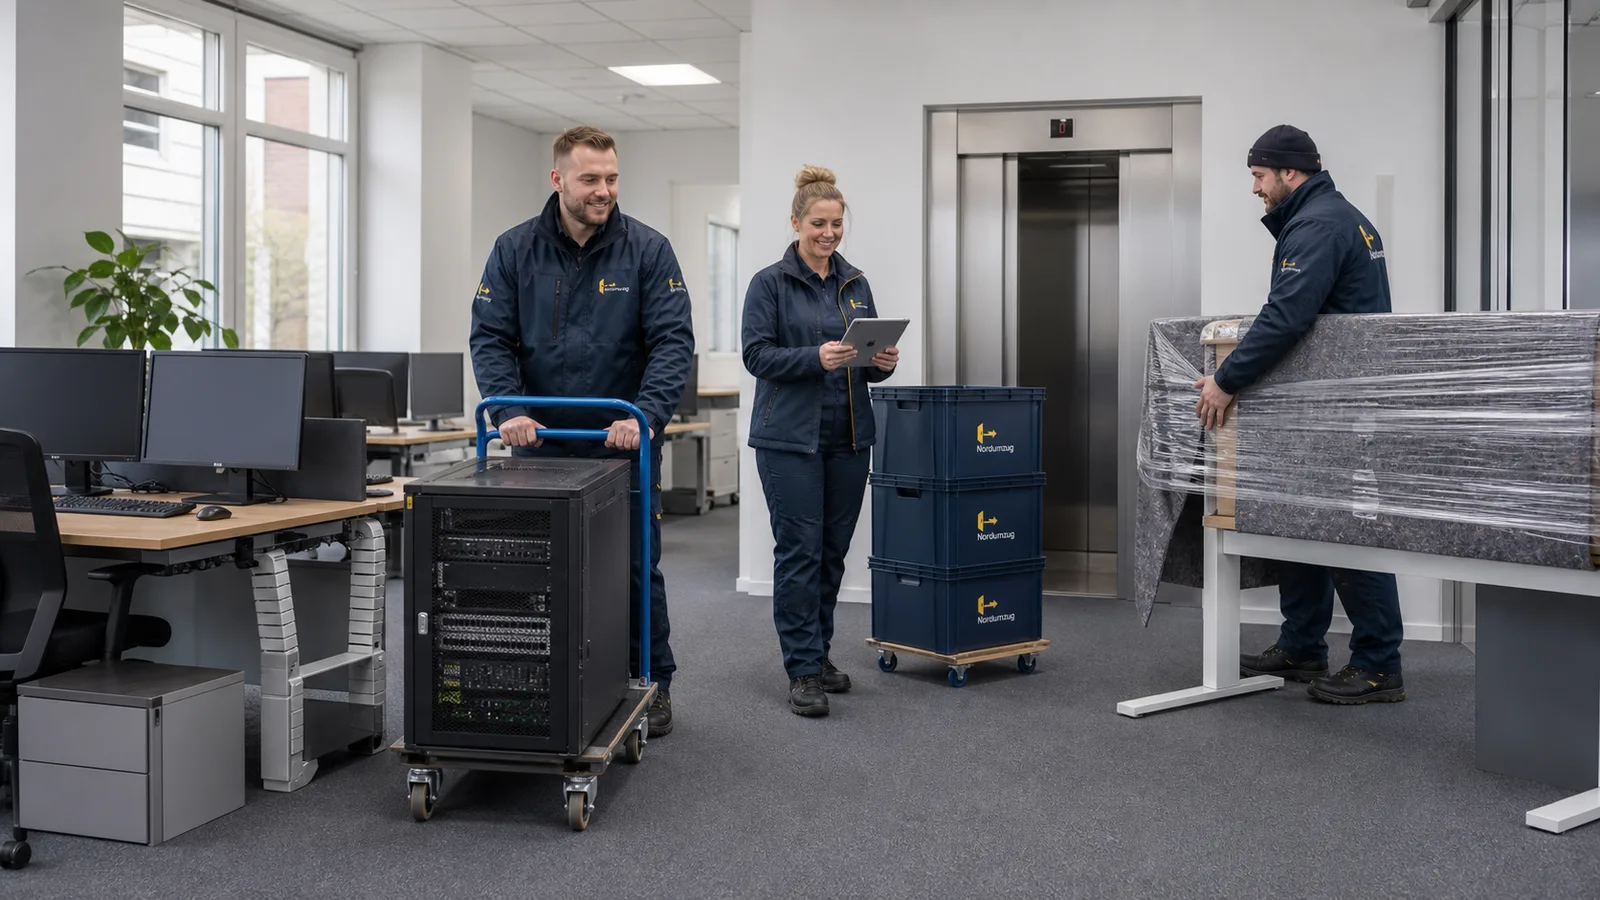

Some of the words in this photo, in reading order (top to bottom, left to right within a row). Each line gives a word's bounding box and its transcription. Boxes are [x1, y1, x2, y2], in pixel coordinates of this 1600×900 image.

[976, 445, 1014, 453] Nordumzug
[977, 532, 1015, 541] Nordumzug
[977, 614, 1015, 624] Nordumzug
